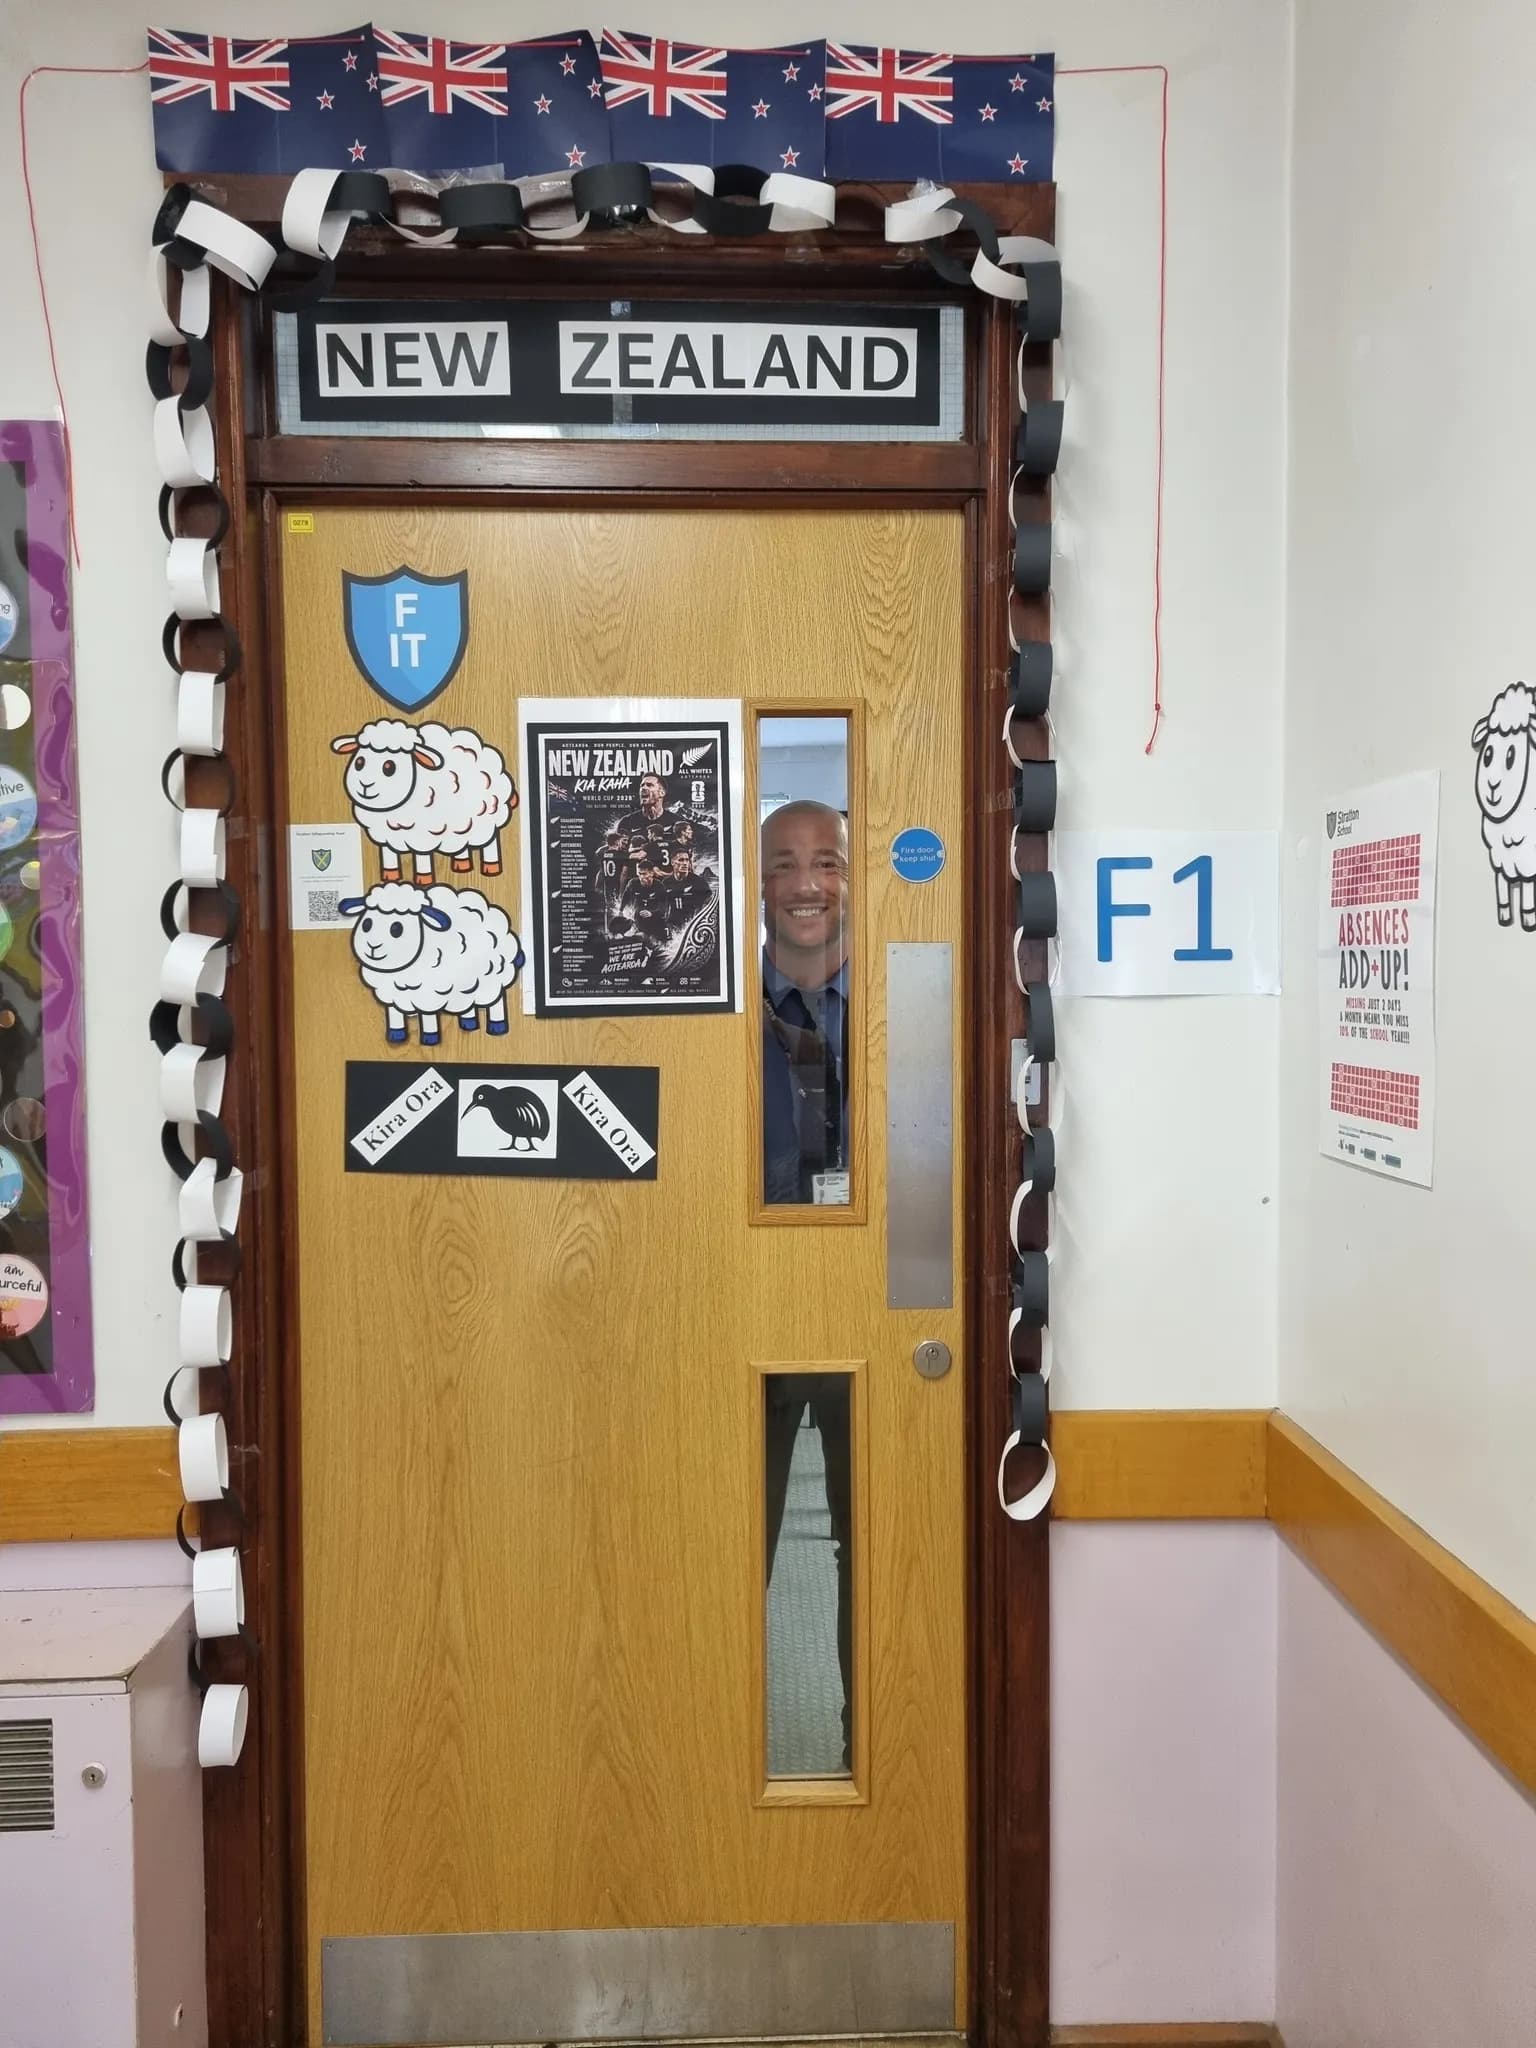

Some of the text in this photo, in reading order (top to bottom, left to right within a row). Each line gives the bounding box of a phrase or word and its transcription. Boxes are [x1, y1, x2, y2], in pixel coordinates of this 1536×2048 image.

[325, 331, 910, 391] NEW ZEALAND
[394, 592, 419, 628] F
[389, 632, 427, 668] IT
[548, 749, 674, 777] NEW ZEALAND
[574, 776, 632, 793] KIA KAHA
[1337, 808, 1360, 825] Stratton
[661, 849, 670, 866] 3
[899, 855, 918, 863] keep
[900, 847, 915, 855] Fire
[603, 860, 616, 877] 10
[1096, 854, 1234, 963] F1
[1338, 907, 1410, 947] ABSENCES
[1345, 997, 1401, 1012] MISSING JUST 2 DAYS
[1344, 1011, 1362, 1024] MONTH
[1363, 1012, 1381, 1025] MEANS
[1382, 1013, 1394, 1026] YOU
[1395, 1015, 1409, 1028] MISS
[1351, 1026, 1357, 1038] OF
[1359, 1027, 1368, 1040] THE
[1370, 1028, 1389, 1042] SCHOOL
[362, 1078, 444, 1152] Kira Ora
[571, 1084, 642, 1166] Kira Ora
[4, 1265, 24, 1277] am
